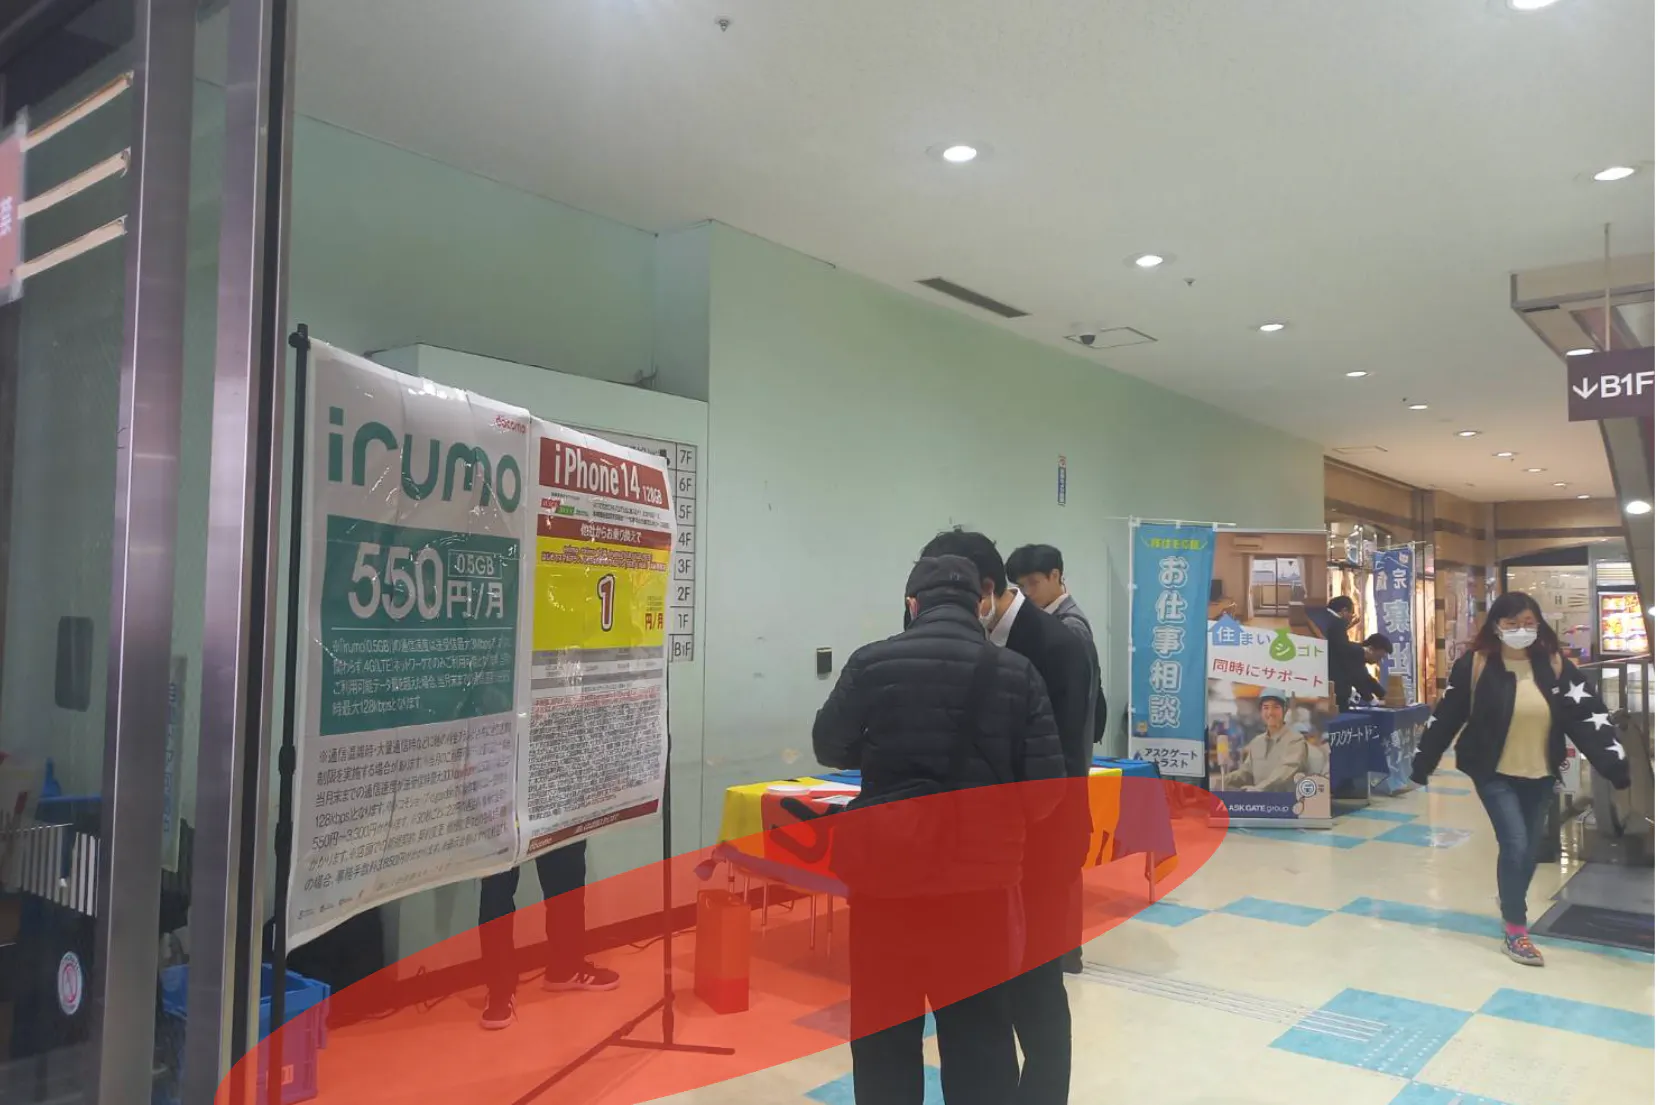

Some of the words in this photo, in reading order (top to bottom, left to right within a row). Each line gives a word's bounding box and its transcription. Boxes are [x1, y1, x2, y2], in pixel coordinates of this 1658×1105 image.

[1600, 371, 1655, 399] B1F
[326, 405, 523, 515] irumo
[680, 450, 694, 465] 7F
[554, 443, 620, 496] iPhone
[620, 461, 641, 500] 14
[641, 485, 664, 505] 128GB
[679, 477, 693, 493] 6F
[678, 503, 693, 520] 5F
[677, 532, 693, 547] 4F
[677, 558, 692, 575] 3F
[347, 541, 444, 621] 550
[447, 580, 505, 621] 円/月
[597, 573, 615, 632] 1
[677, 586, 691, 602] 2F
[645, 612, 664, 631] 円/月
[677, 612, 689, 629] 1F
[673, 641, 692, 657] B1F
[1150, 555, 1190, 728] お仕事相談
[1212, 658, 1323, 688] 同時にサポート
[1144, 748, 1198, 760] アスクゲート
[1229, 804, 1245, 812] ASK
[1245, 804, 1266, 812] GATE
[1266, 804, 1289, 813] group
